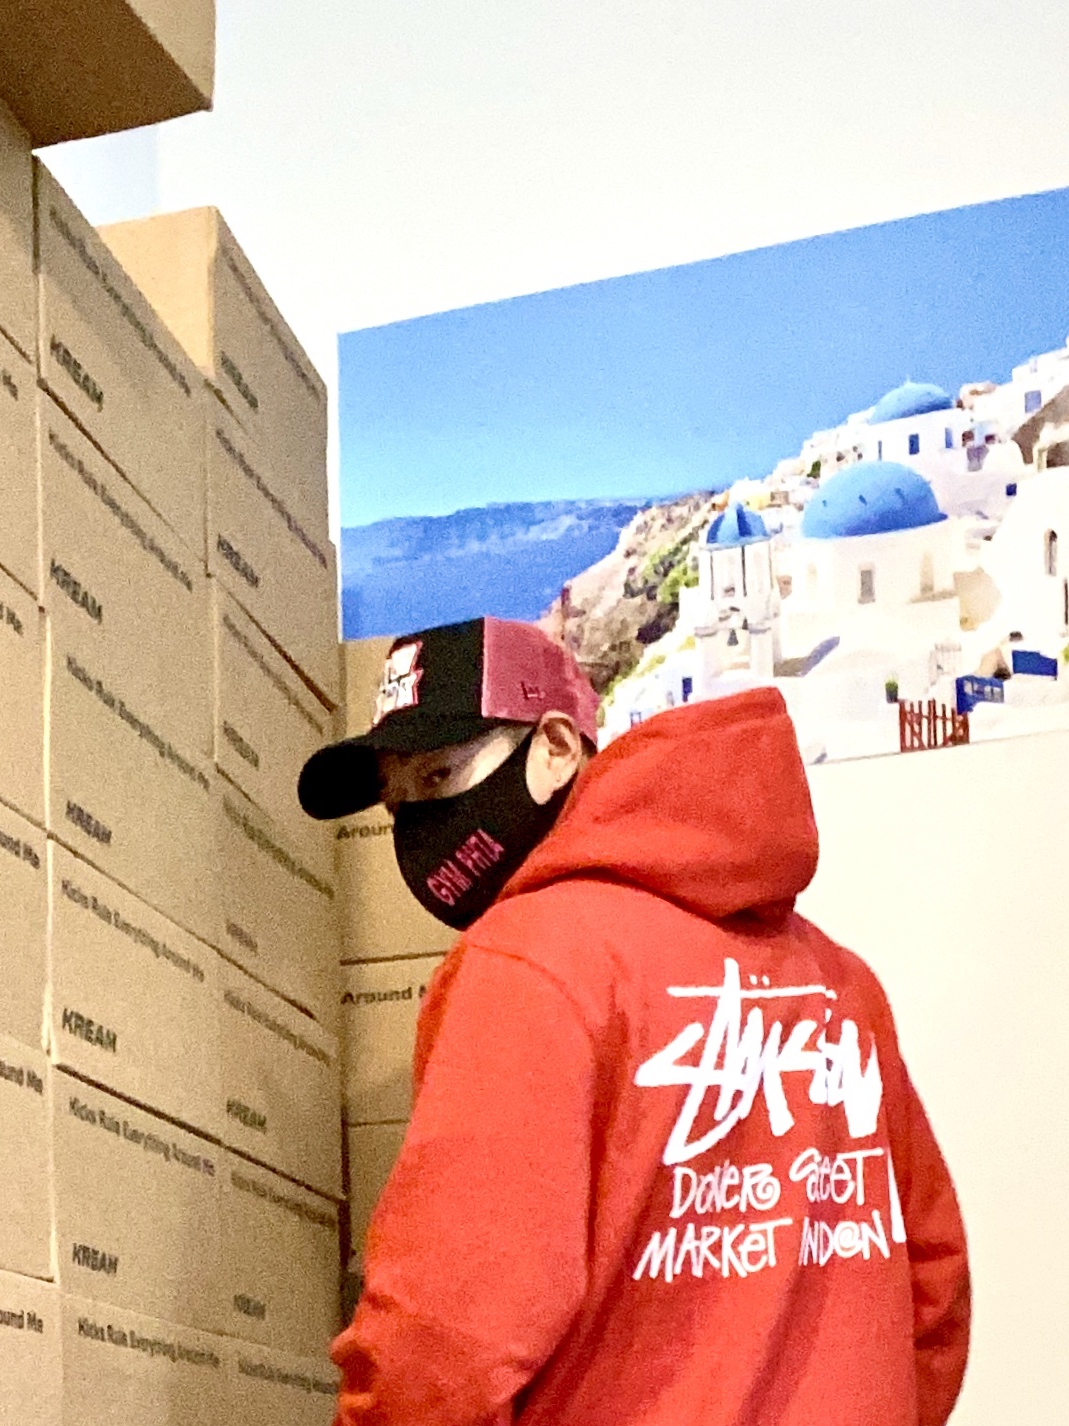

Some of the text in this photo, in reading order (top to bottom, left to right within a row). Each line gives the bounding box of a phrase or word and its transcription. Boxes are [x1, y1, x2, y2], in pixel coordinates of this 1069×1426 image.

[337, 822, 395, 841] Aroun
[340, 986, 413, 1006] Around
[61, 1007, 117, 1053] KREAM
[71, 1242, 119, 1276] KREAM
